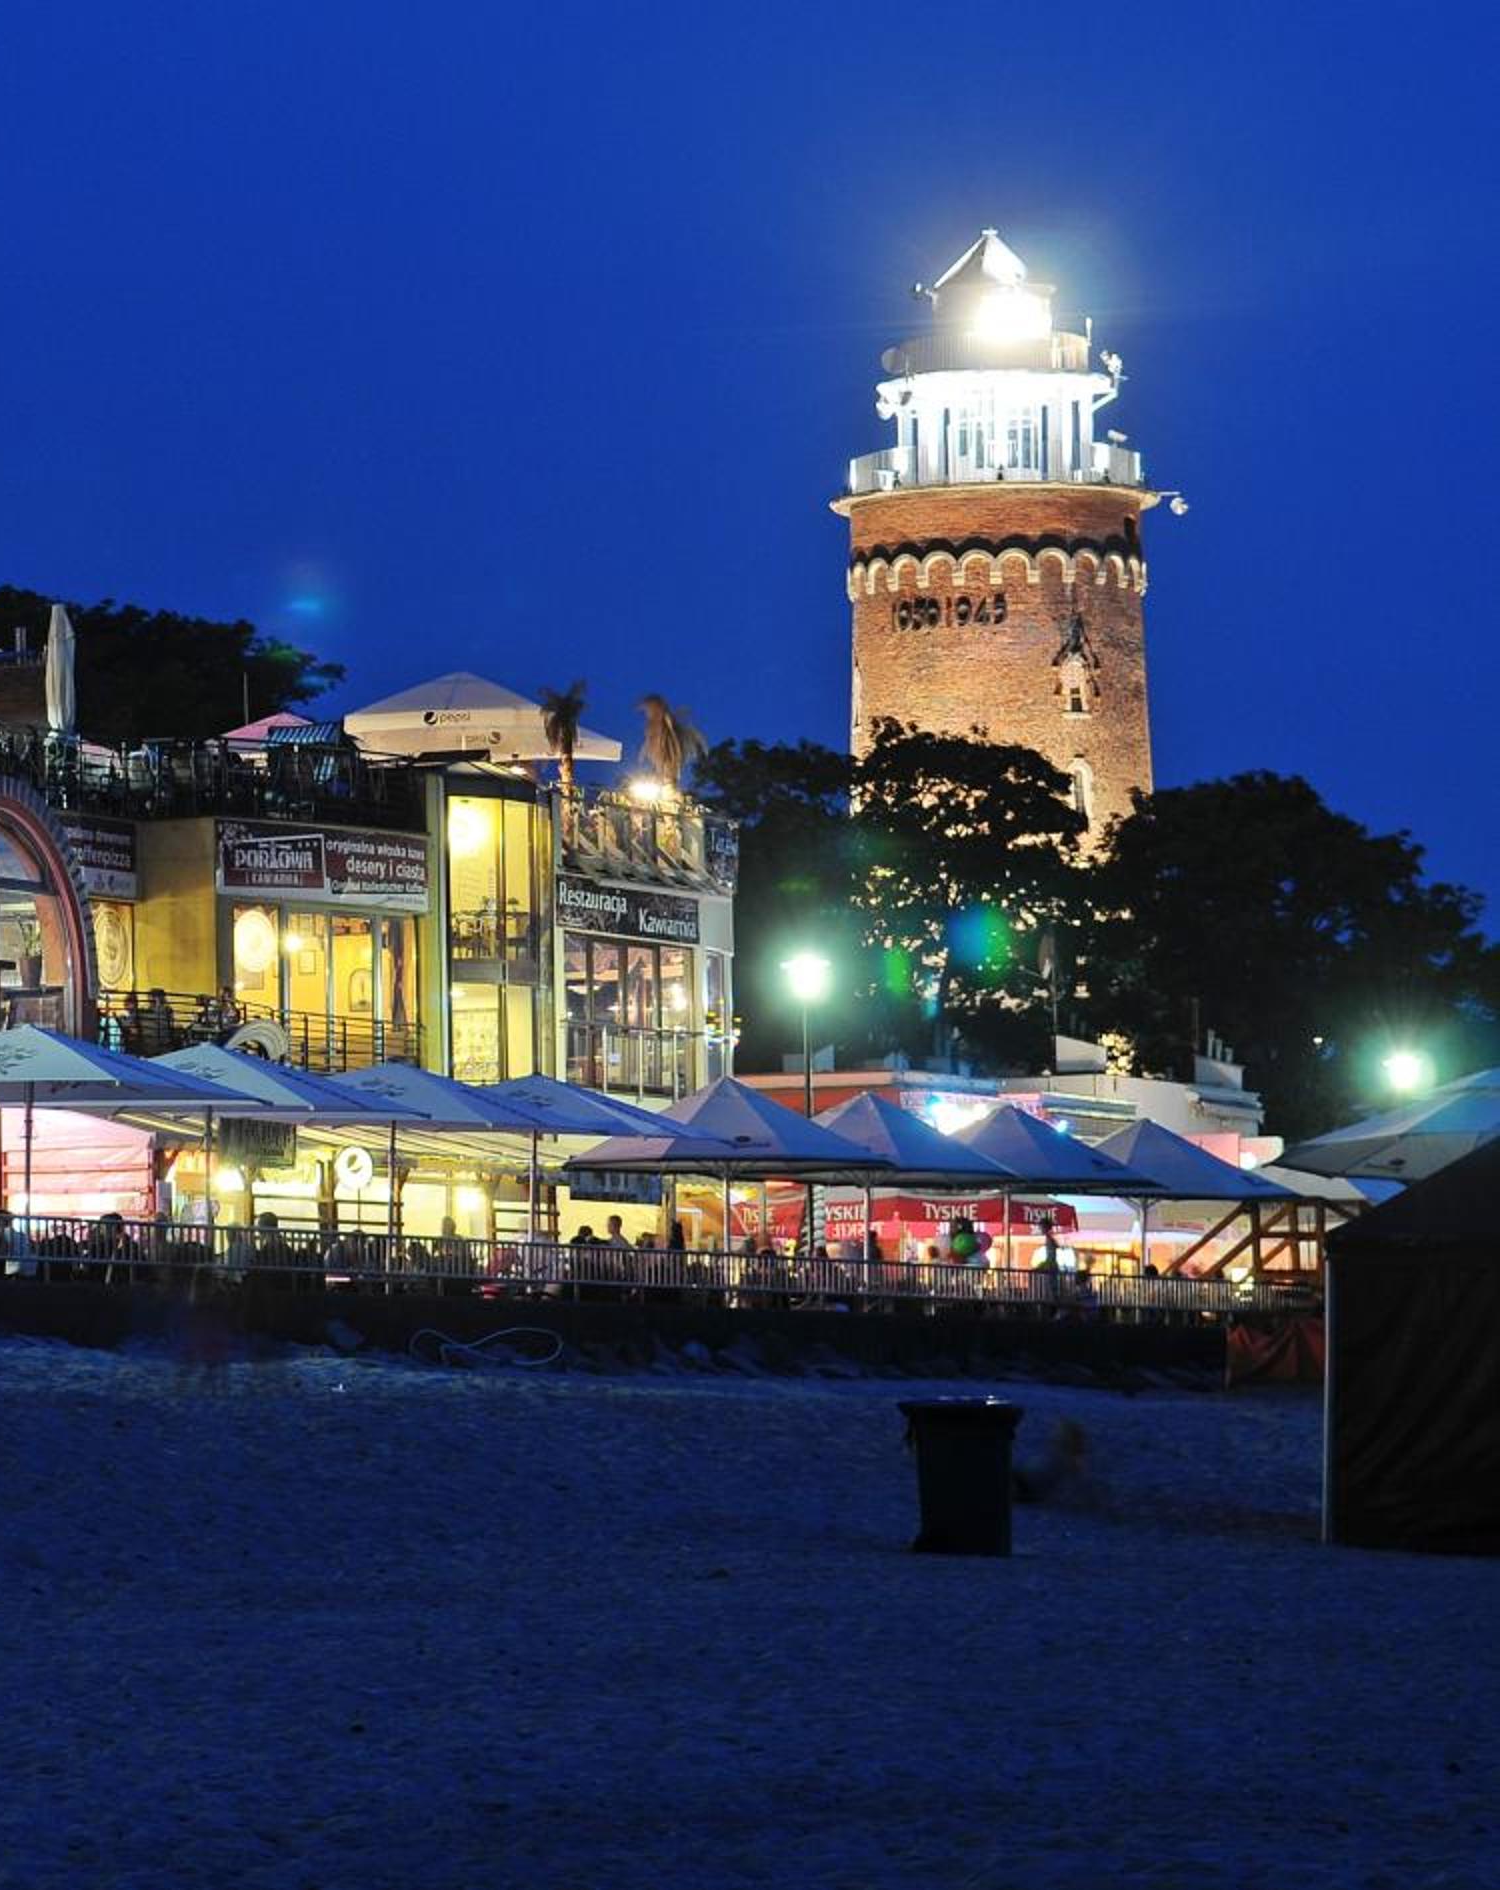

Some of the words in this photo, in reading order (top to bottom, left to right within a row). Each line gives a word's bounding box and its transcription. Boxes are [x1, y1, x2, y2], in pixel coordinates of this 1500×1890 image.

[346, 855, 387, 880] desery
[395, 861, 425, 881] ciasta
[559, 882, 628, 923] Restauracja
[638, 907, 697, 938] Kawiarnia
[922, 1202, 979, 1221] TYSKIE
